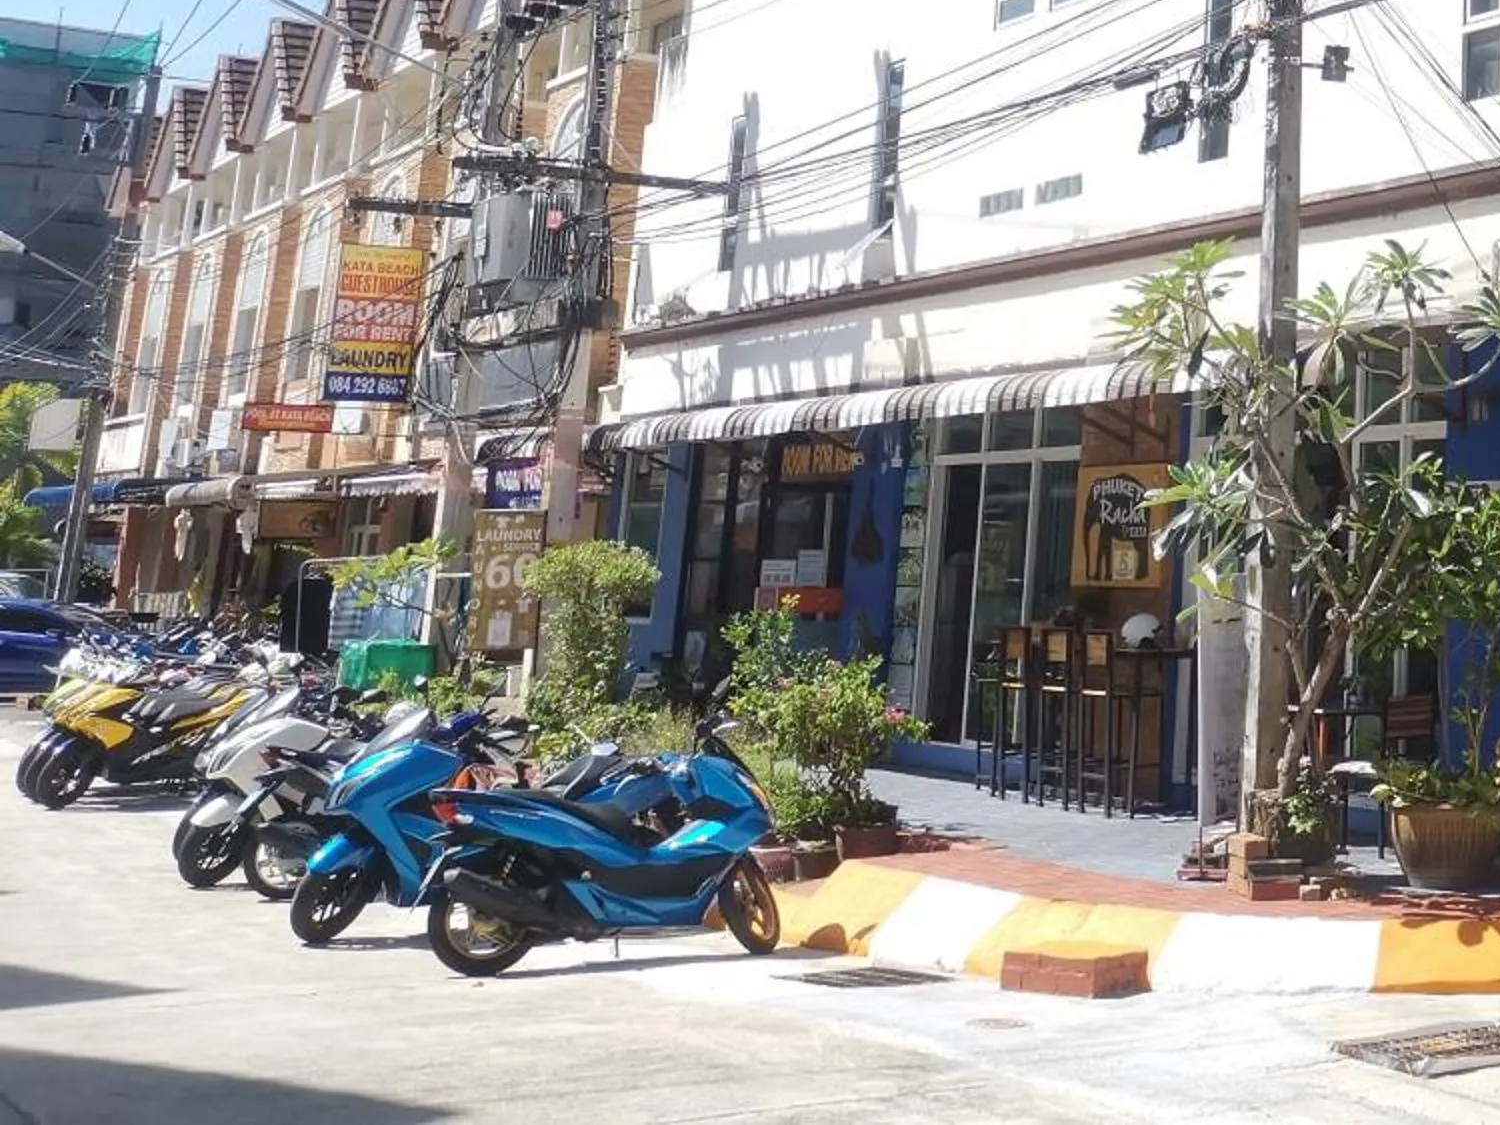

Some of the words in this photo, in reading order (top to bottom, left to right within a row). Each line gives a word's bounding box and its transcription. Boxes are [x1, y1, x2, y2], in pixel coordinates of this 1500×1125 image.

[343, 260, 373, 272] KATA
[377, 263, 419, 276] BEACH
[336, 299, 416, 325] ROOM
[333, 324, 365, 340] FOR
[370, 326, 412, 342] RENT
[331, 349, 408, 368] LAUNDRY
[328, 376, 351, 394] 084
[352, 377, 375, 394] 292
[782, 444, 812, 476] ROOM
[812, 443, 834, 474] FOR
[1092, 478, 1146, 502] PHUKET
[1099, 499, 1147, 524] Racha
[476, 528, 543, 541] LAUNDRY
